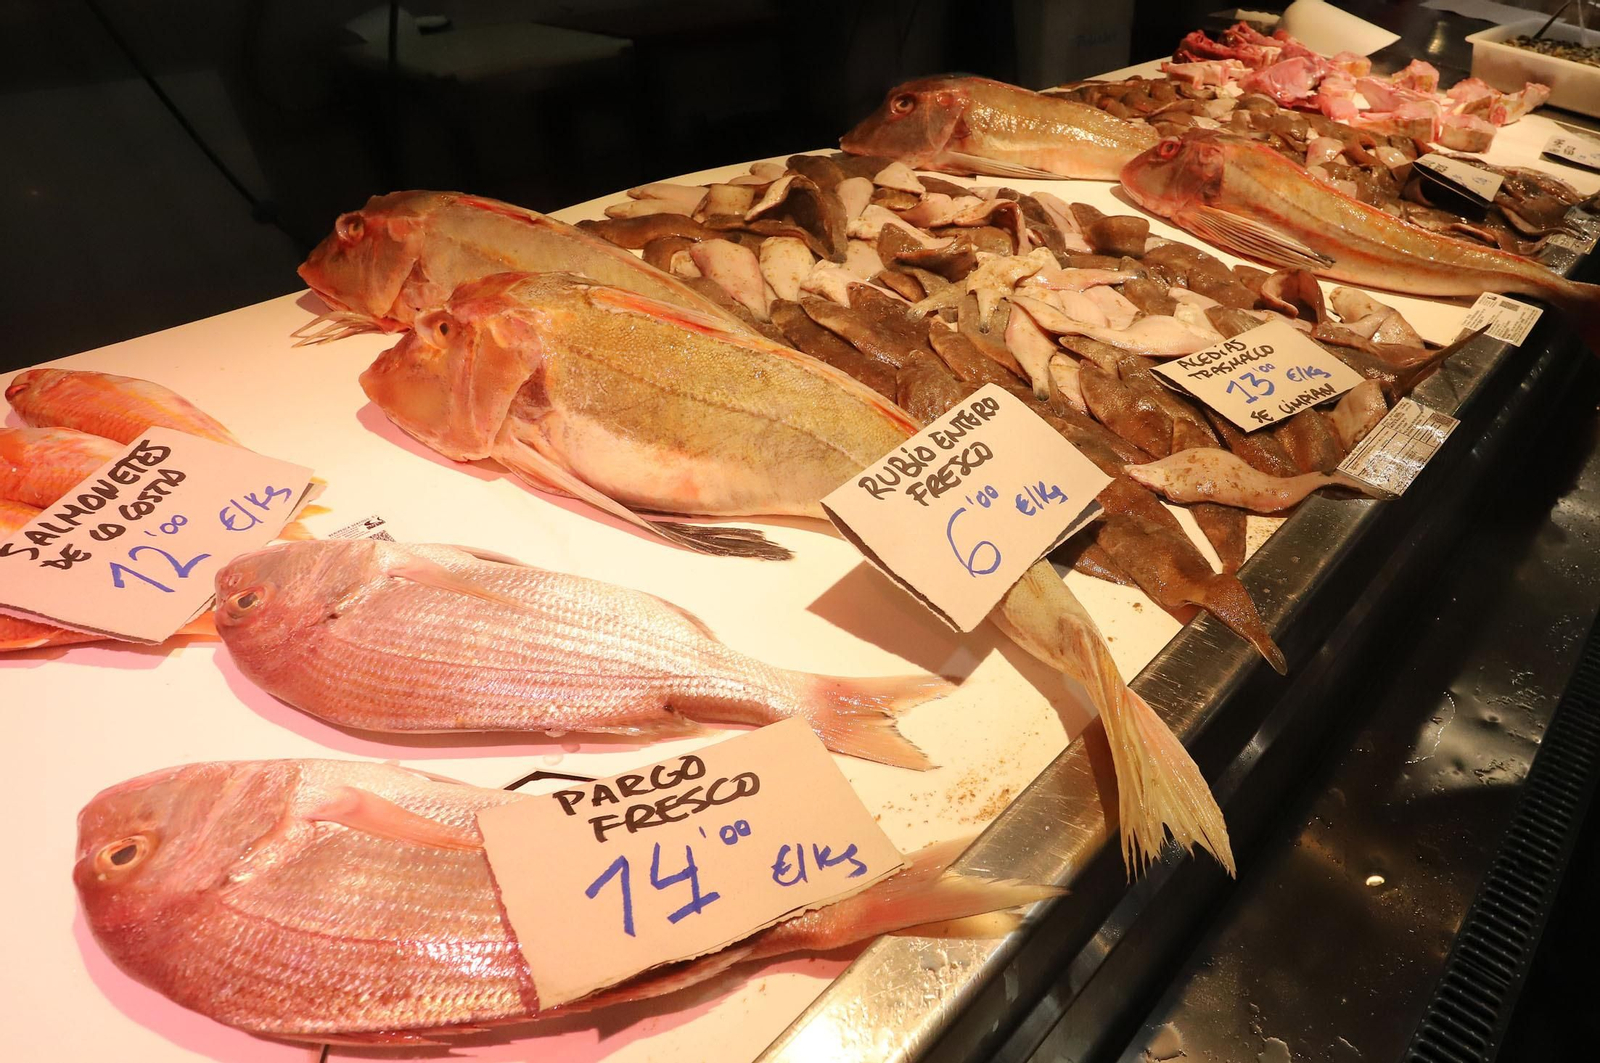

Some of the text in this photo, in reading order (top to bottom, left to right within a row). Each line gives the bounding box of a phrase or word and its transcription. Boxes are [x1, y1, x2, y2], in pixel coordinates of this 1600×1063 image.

[1176, 338, 1247, 371] ACEDIAS
[927, 396, 1001, 450] ENTERO
[1250, 408, 1274, 424] SE
[0, 438, 172, 562] SALMONETES
[905, 441, 994, 507] FRESCO
[38, 542, 93, 570] DE
[552, 754, 707, 817] PARGO
[588, 771, 761, 843] FRESCO
